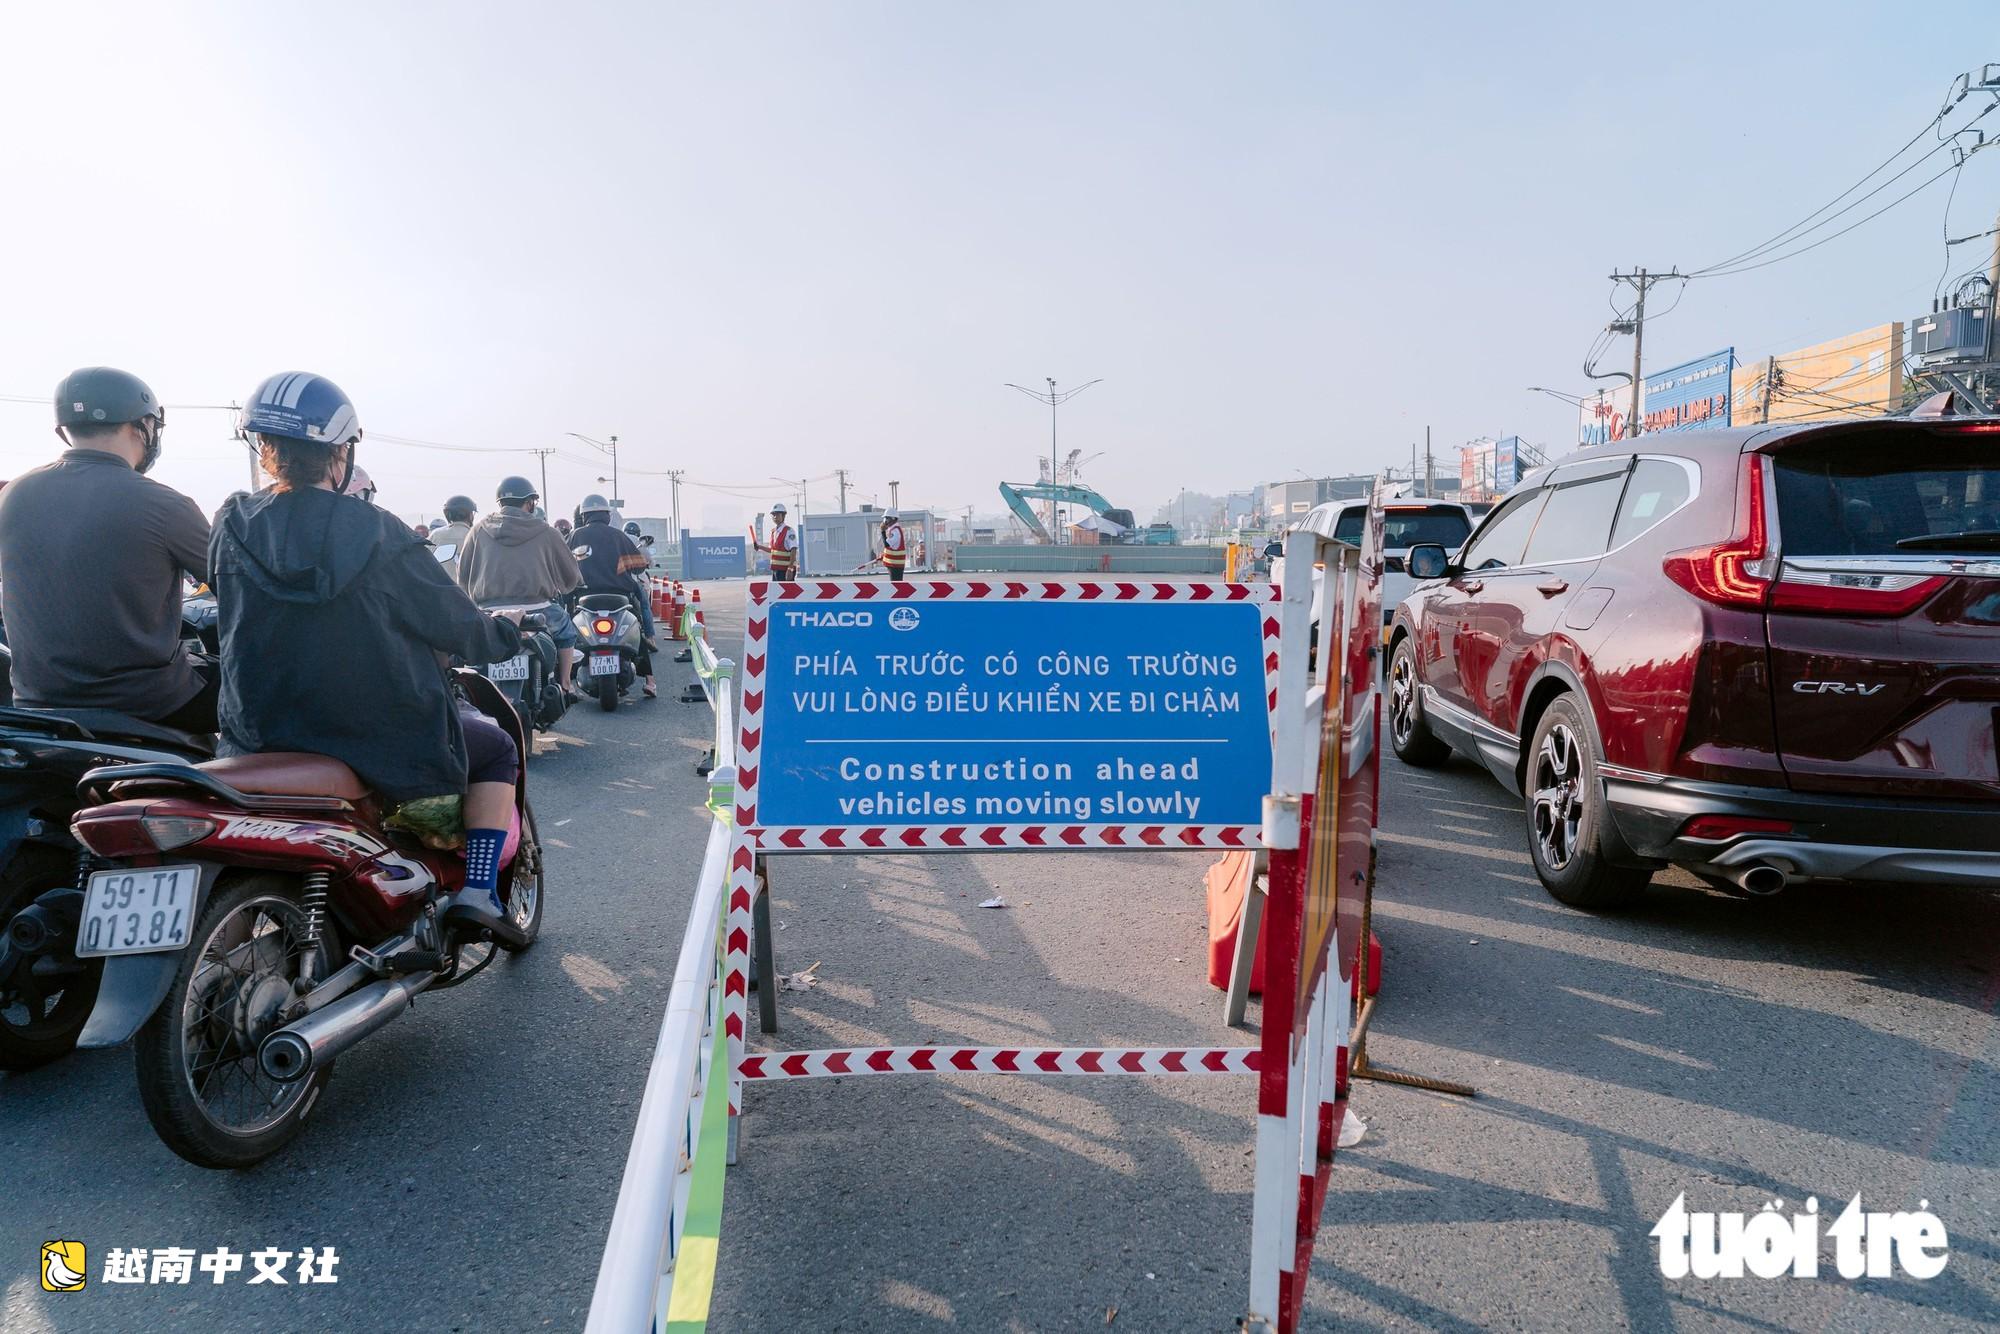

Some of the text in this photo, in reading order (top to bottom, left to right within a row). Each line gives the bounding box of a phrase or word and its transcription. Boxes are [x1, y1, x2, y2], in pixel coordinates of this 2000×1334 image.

[1681, 397, 1711, 425] LINH
[697, 546, 738, 556] THACO
[784, 611, 873, 627] THACO
[492, 667, 525, 679] 403.90
[795, 650, 1237, 676] PHÍA TRƯỚC CÓ CÔNG TRƯỜNG
[793, 682, 1240, 717] VUI LÒNG ĐIỀU KHIỂN XE ĐI CHẬM
[1792, 681, 1887, 696] CR-V
[840, 757, 1199, 781] Construction ahead
[839, 791, 1201, 820] vehicles moving slowly
[101, 871, 180, 911] 59-T1
[86, 909, 183, 948] 013.84
